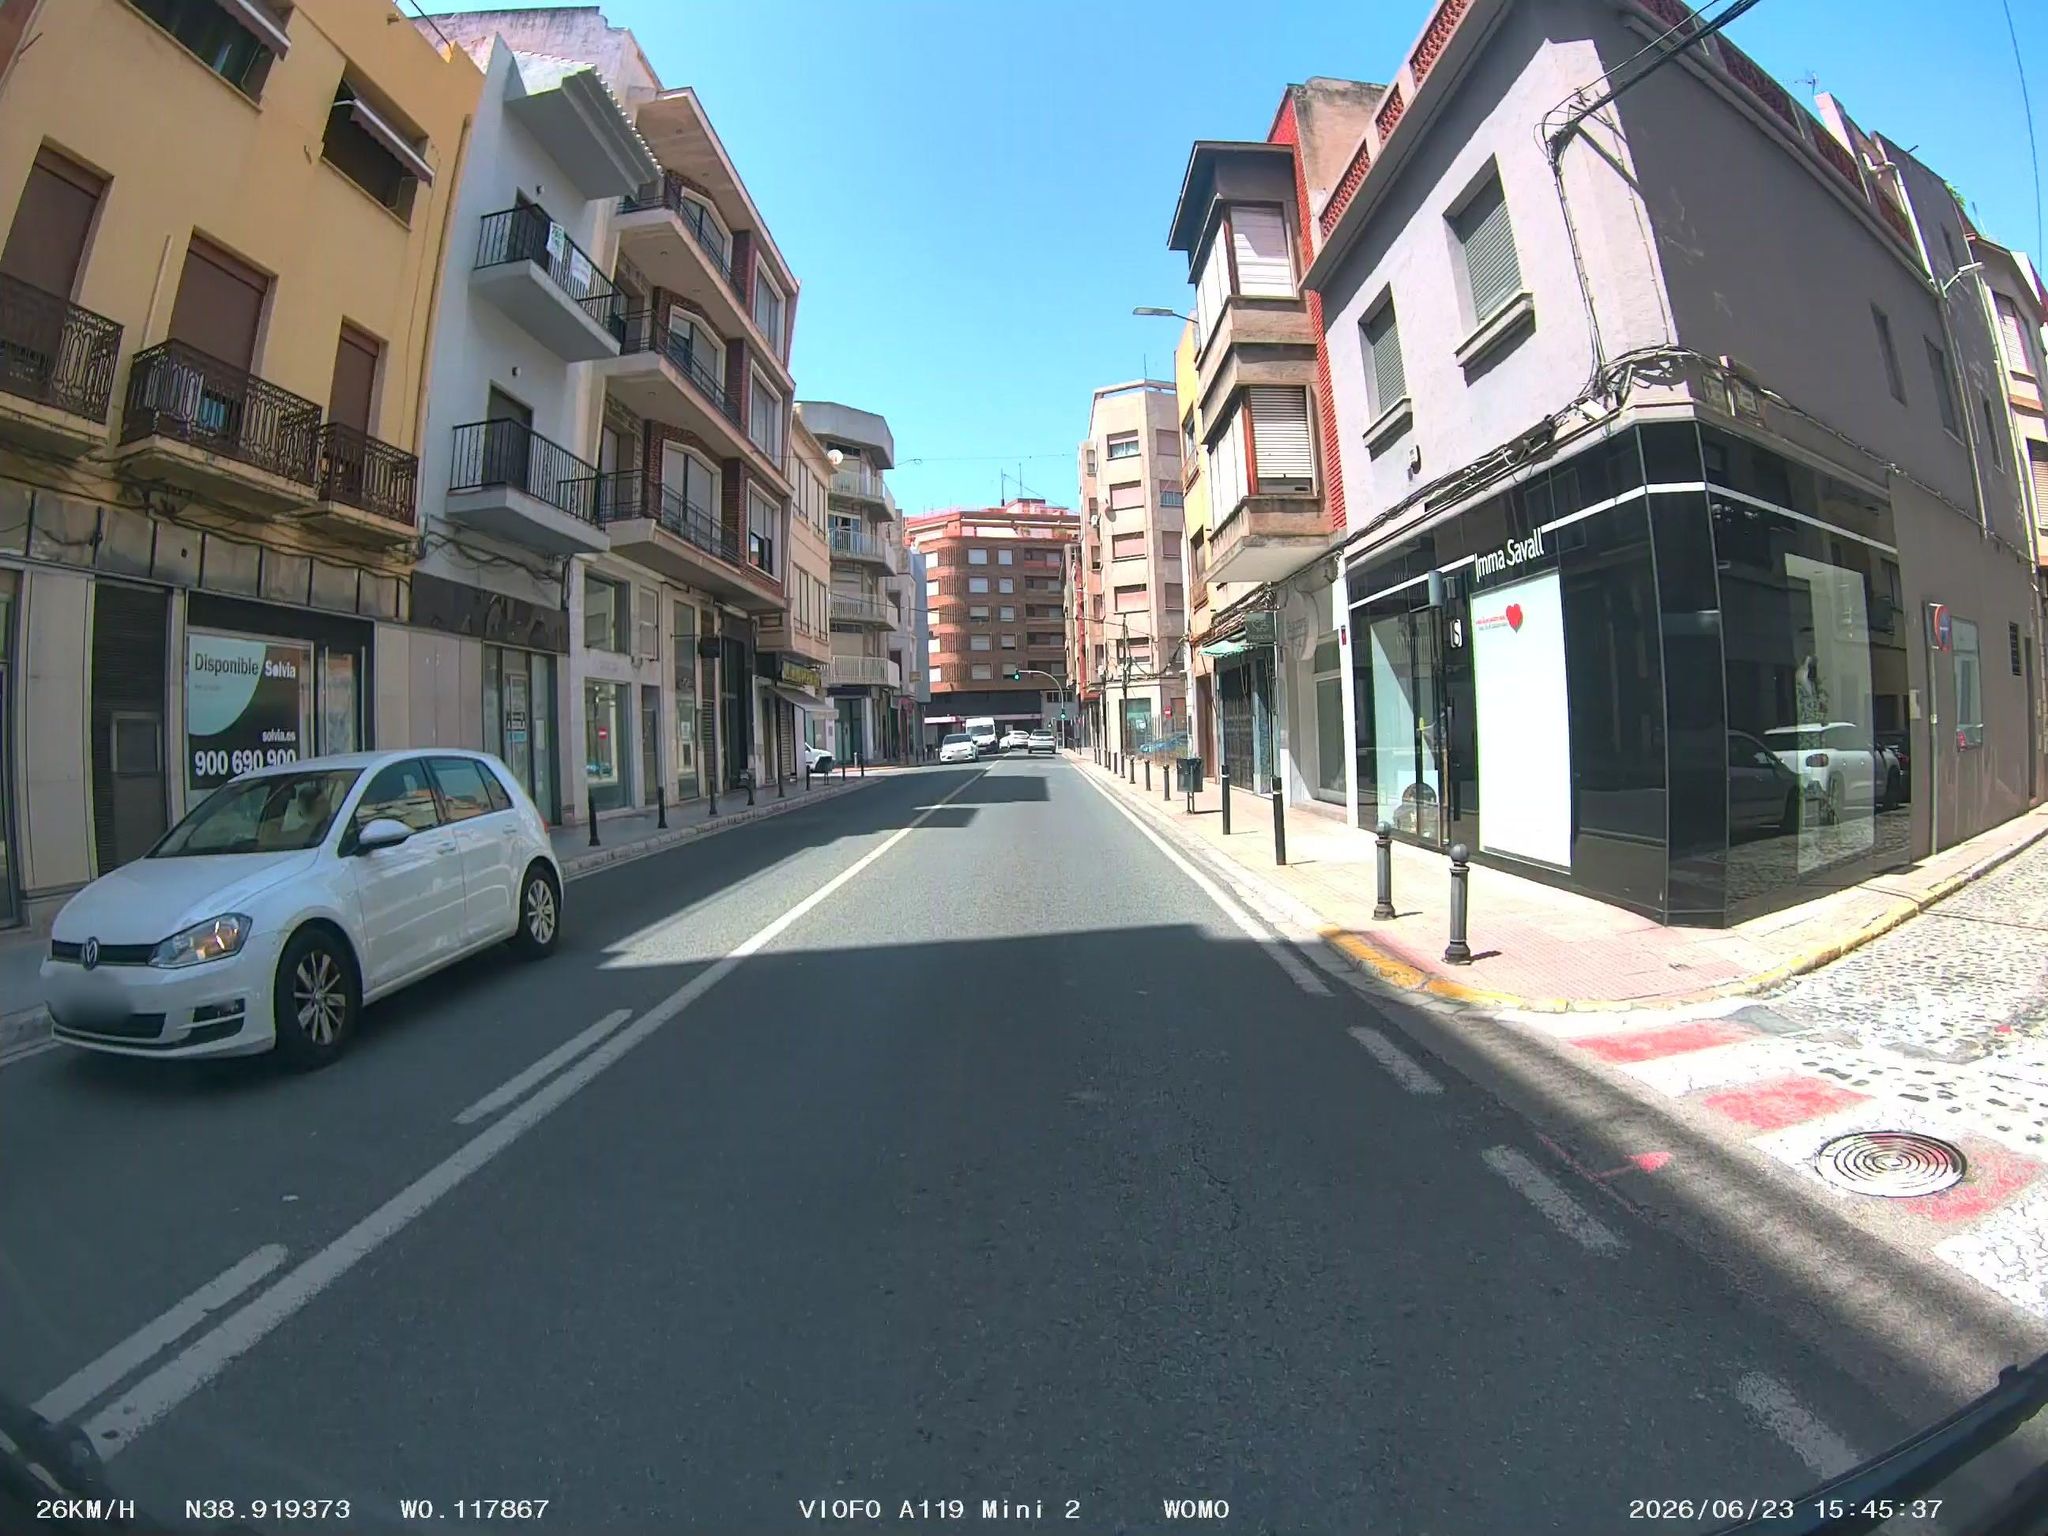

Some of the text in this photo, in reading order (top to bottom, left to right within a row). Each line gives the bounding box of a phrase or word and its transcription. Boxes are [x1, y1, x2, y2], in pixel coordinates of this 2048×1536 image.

[1474, 527, 1544, 583] Imma Savall
[195, 653, 259, 676] Disponible
[264, 660, 296, 679] Solvia
[262, 729, 296, 743] solvia.es
[195, 751, 228, 776] 900
[232, 750, 264, 774] 690
